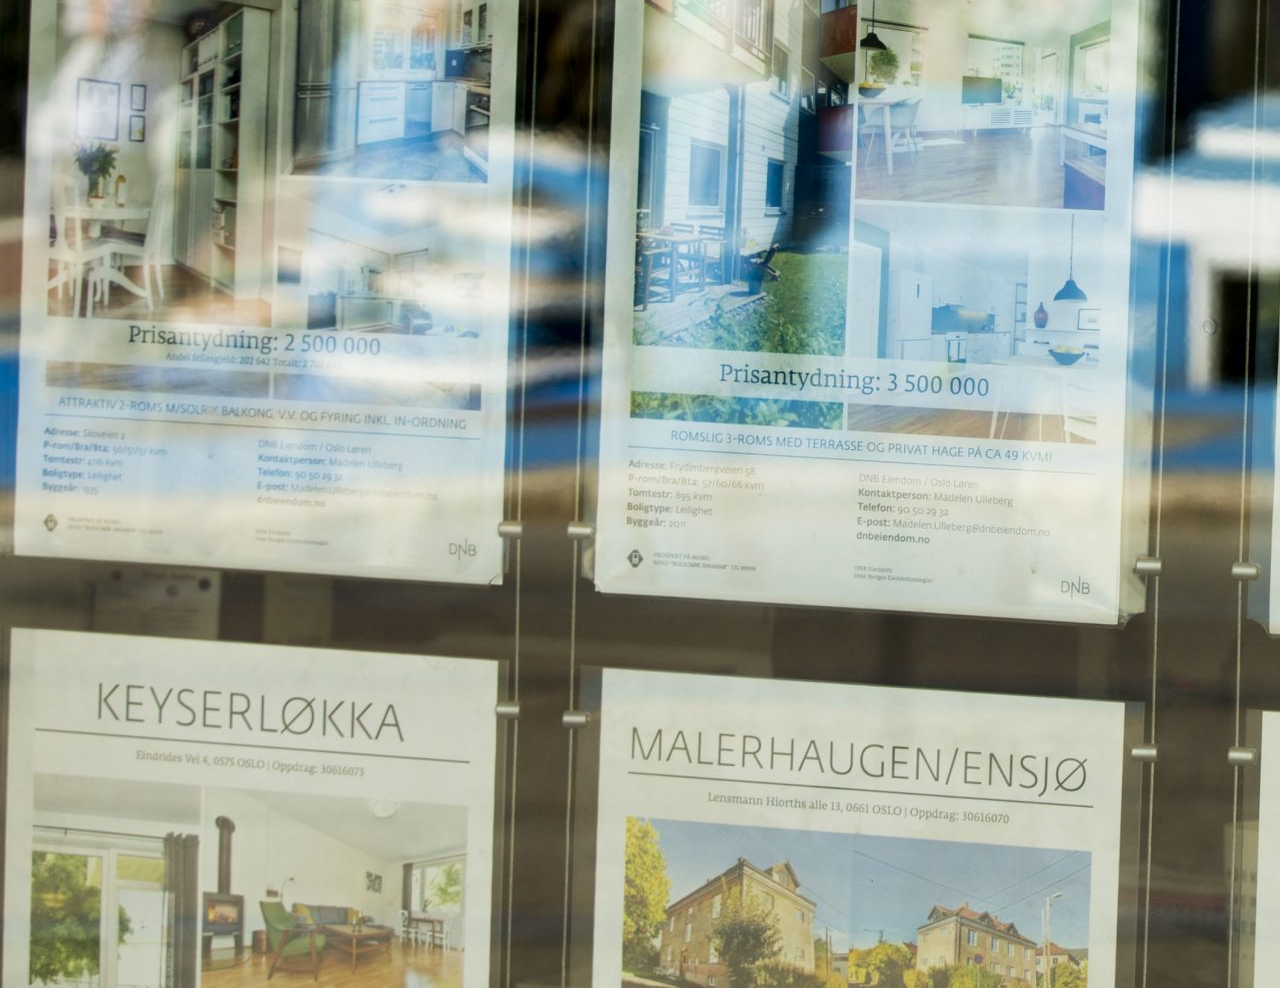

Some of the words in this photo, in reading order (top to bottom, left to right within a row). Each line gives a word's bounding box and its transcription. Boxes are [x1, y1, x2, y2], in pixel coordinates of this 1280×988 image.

[127, 325, 278, 355] Prisantydning:
[284, 332, 295, 351] 2
[300, 334, 336, 352] 500
[343, 336, 380, 356] 000
[719, 363, 880, 395] Prisantydning:
[887, 372, 897, 391] 3
[904, 373, 942, 394] 500
[949, 376, 989, 396] 000
[448, 537, 477, 561] DNB
[855, 531, 930, 544] dnbeiendom.no
[1060, 575, 1090, 596] DNB
[97, 682, 404, 742] KEYSERLØKKA
[631, 726, 1087, 793] MALERHAUGEN/ENSJØ
[707, 791, 762, 805] Lensmann
[765, 796, 806, 809] Hiorths
[808, 799, 828, 810] alle
[830, 801, 843, 812] 13,
[845, 802, 869, 813] 0661
[871, 804, 902, 816] OSLO
[909, 807, 958, 821] Oppdrag:
[961, 811, 1009, 824] 30616070
